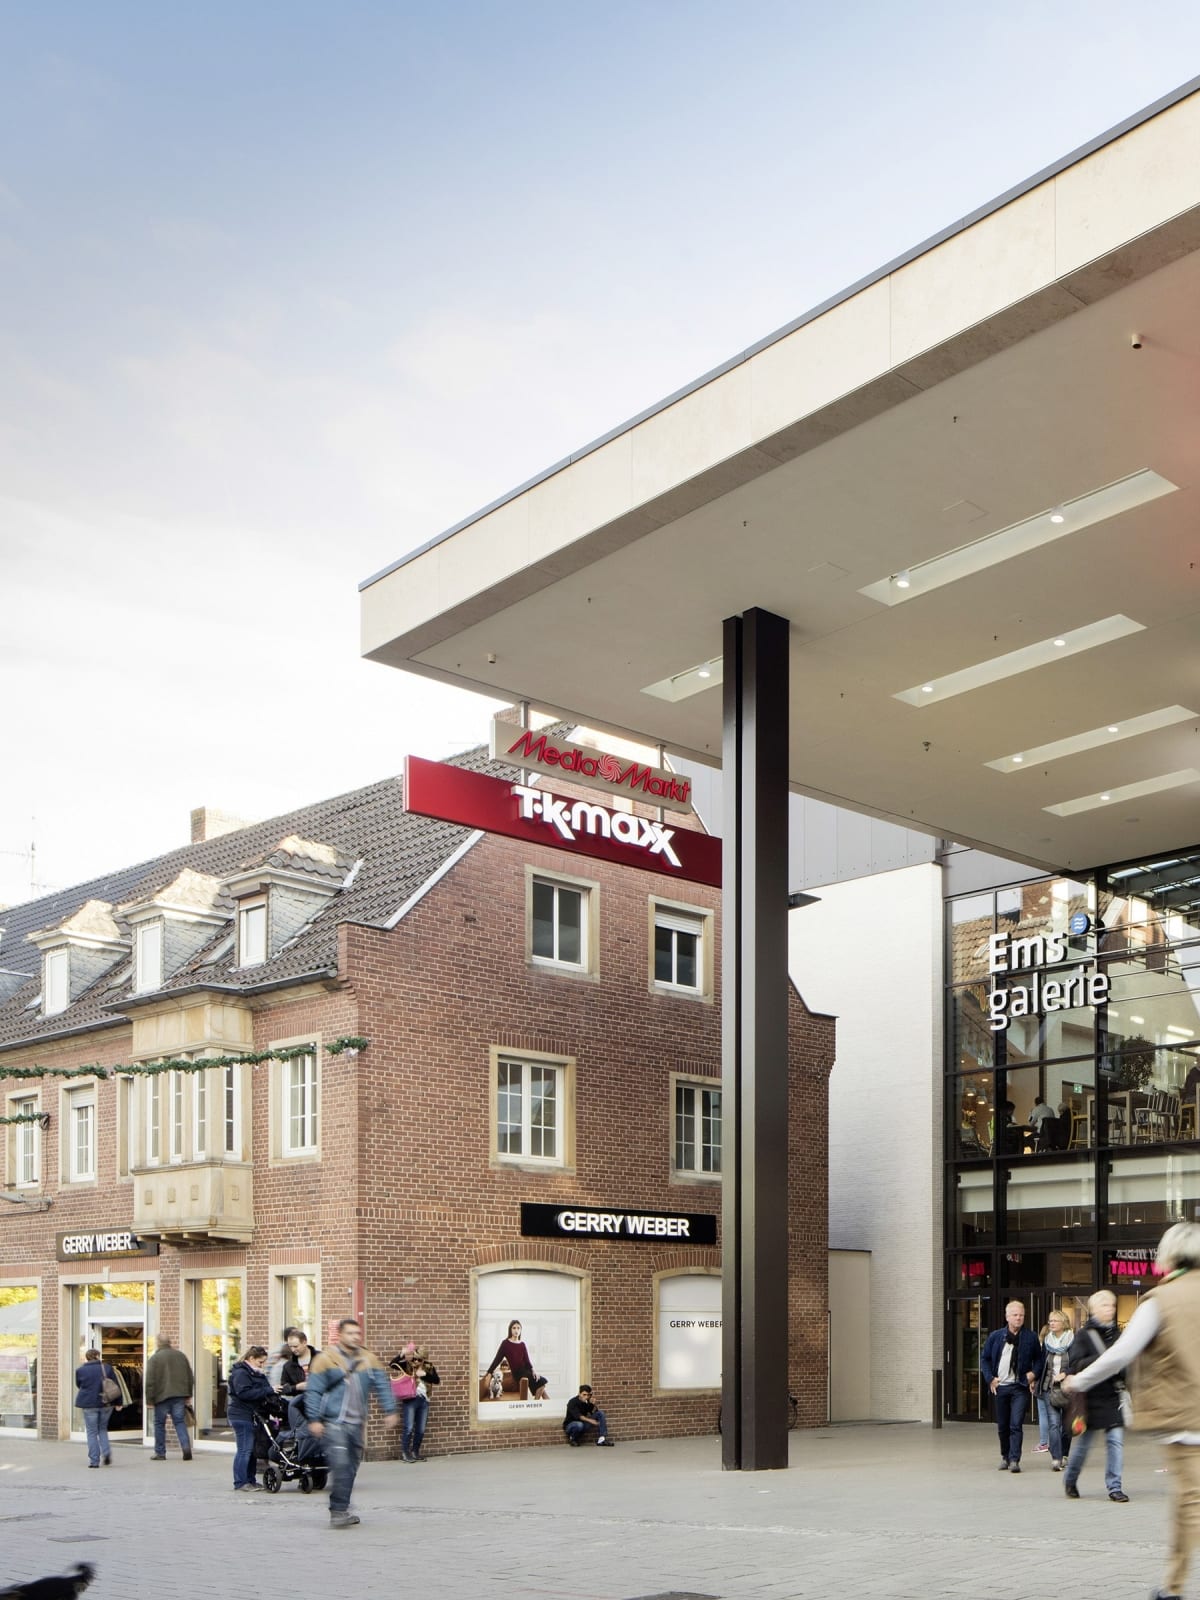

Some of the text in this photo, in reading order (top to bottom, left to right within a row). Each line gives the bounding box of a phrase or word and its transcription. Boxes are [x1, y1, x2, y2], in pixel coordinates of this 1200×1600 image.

[507, 730, 692, 803] Media Markt
[989, 932, 1066, 973] Ems
[989, 964, 1110, 1031] galerie
[558, 1211, 690, 1237] GERRY WEBER
[62, 1232, 132, 1254] GERRY WEBER
[1109, 1260, 1148, 1276] TALLY
[670, 1320, 695, 1328] GERRY
